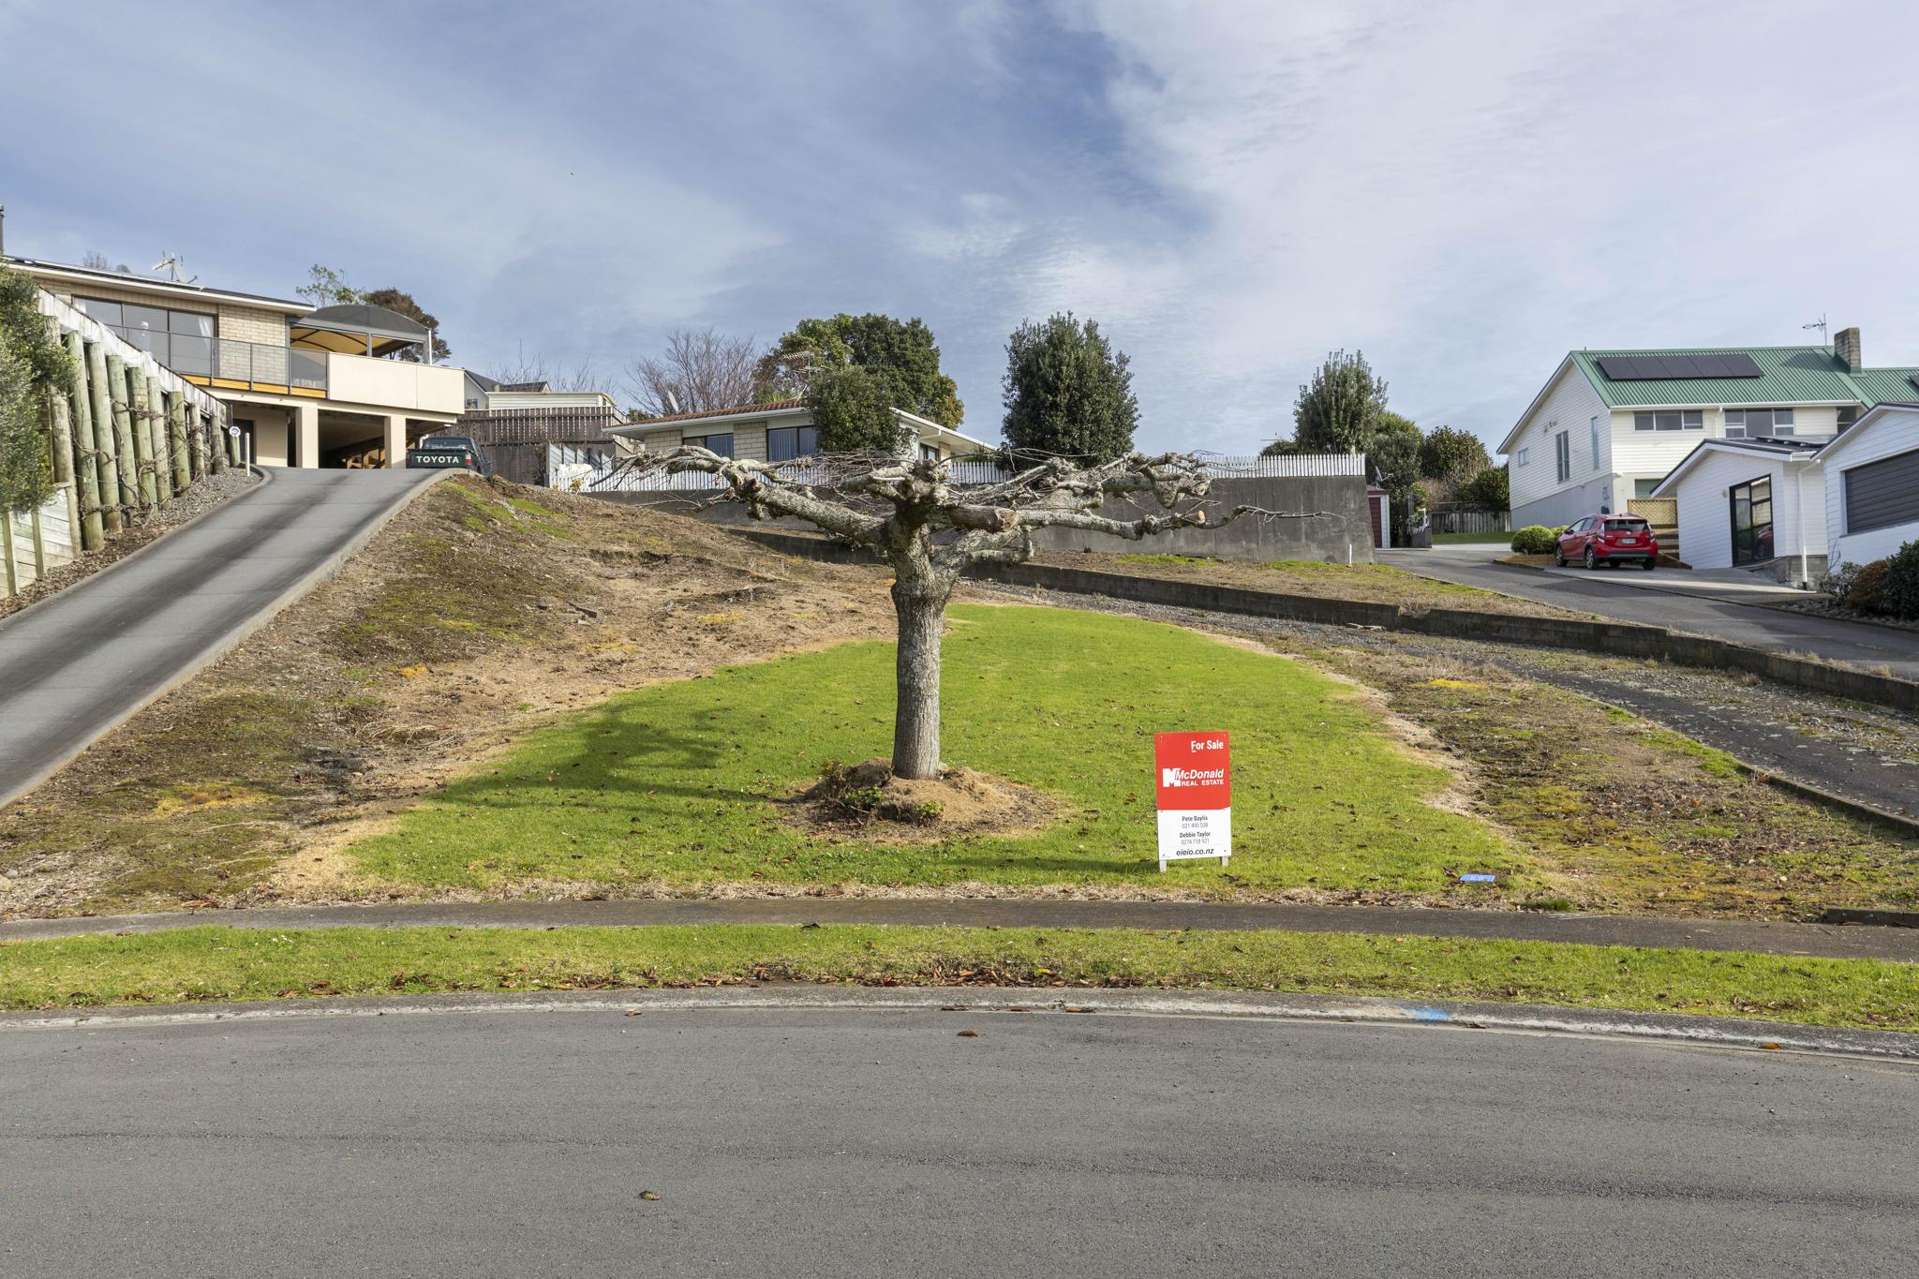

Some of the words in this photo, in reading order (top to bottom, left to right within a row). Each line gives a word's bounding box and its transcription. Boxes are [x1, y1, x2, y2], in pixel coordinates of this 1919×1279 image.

[416, 455, 460, 464] TOYOTA
[1191, 740, 1205, 750] For
[1206, 739, 1224, 750] Sale
[1176, 768, 1224, 780] McDonald
